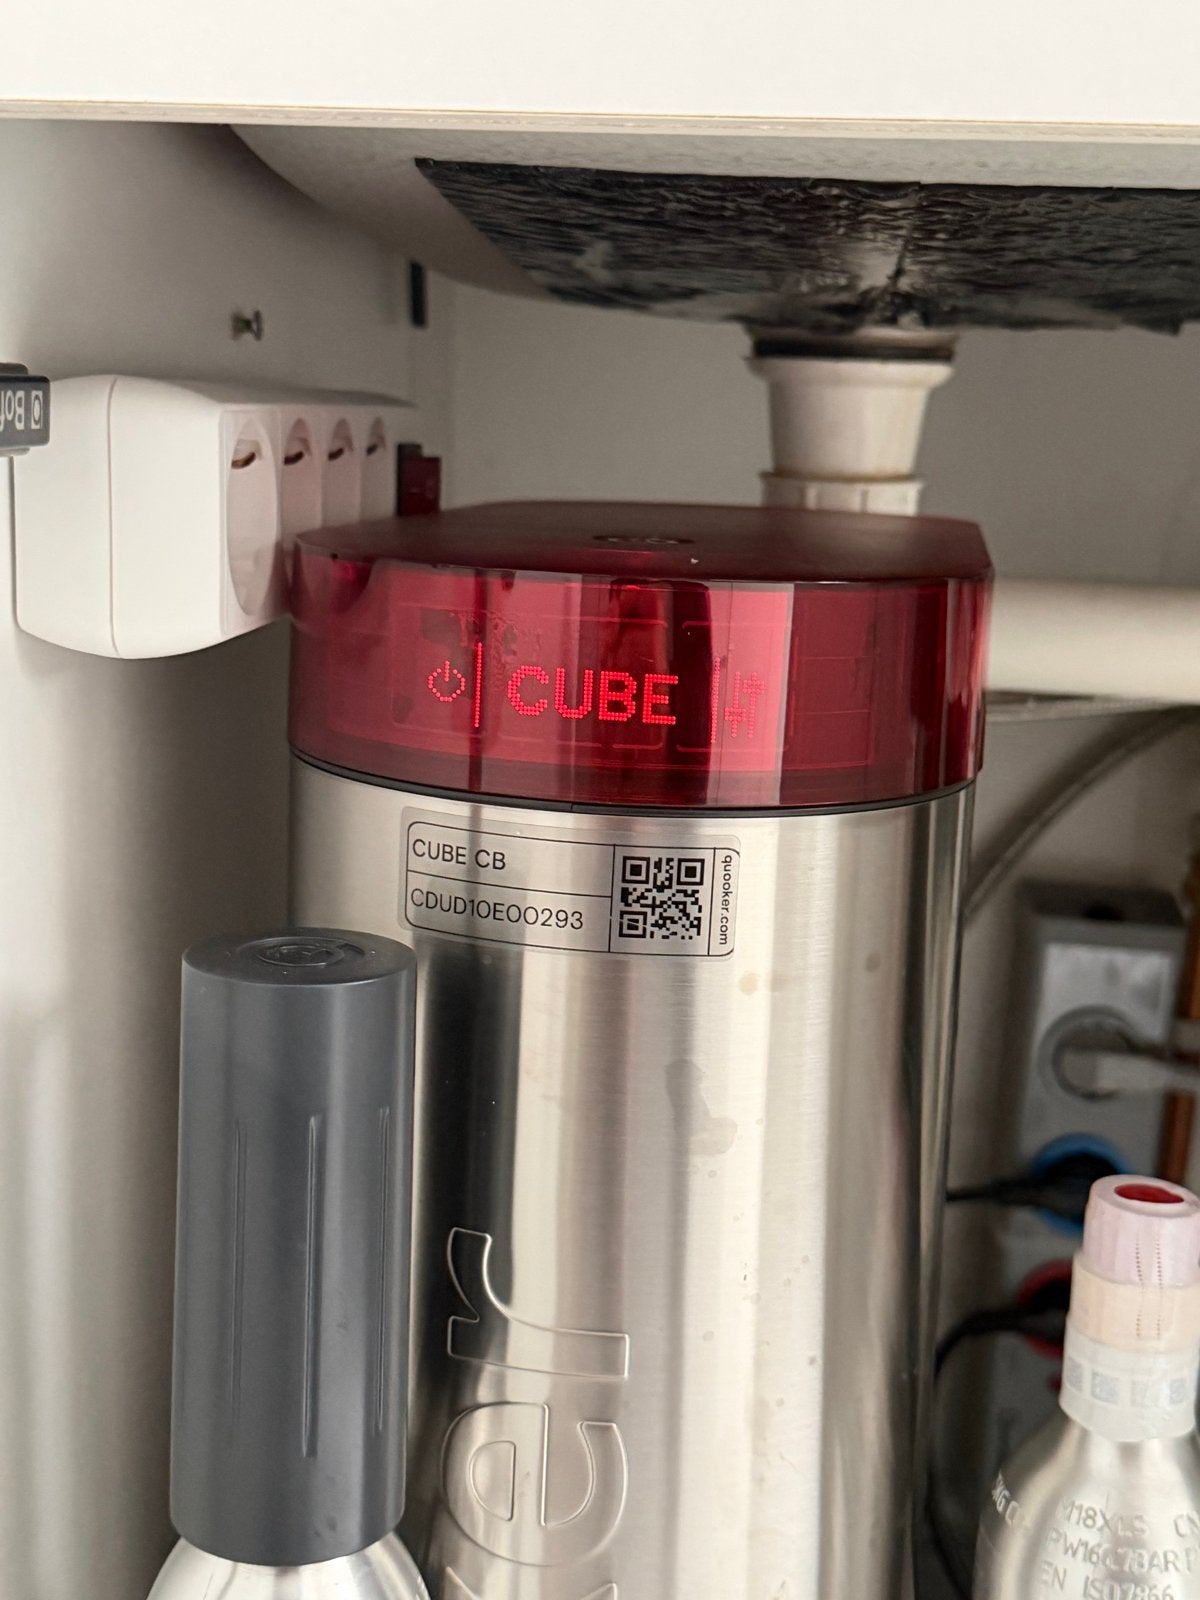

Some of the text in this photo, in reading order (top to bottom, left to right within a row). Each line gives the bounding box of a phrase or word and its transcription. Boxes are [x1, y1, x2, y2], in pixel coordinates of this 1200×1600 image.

[508, 665, 679, 726] CUBE
[412, 838, 507, 871] CUBE CB
[719, 854, 733, 945] quooker.com
